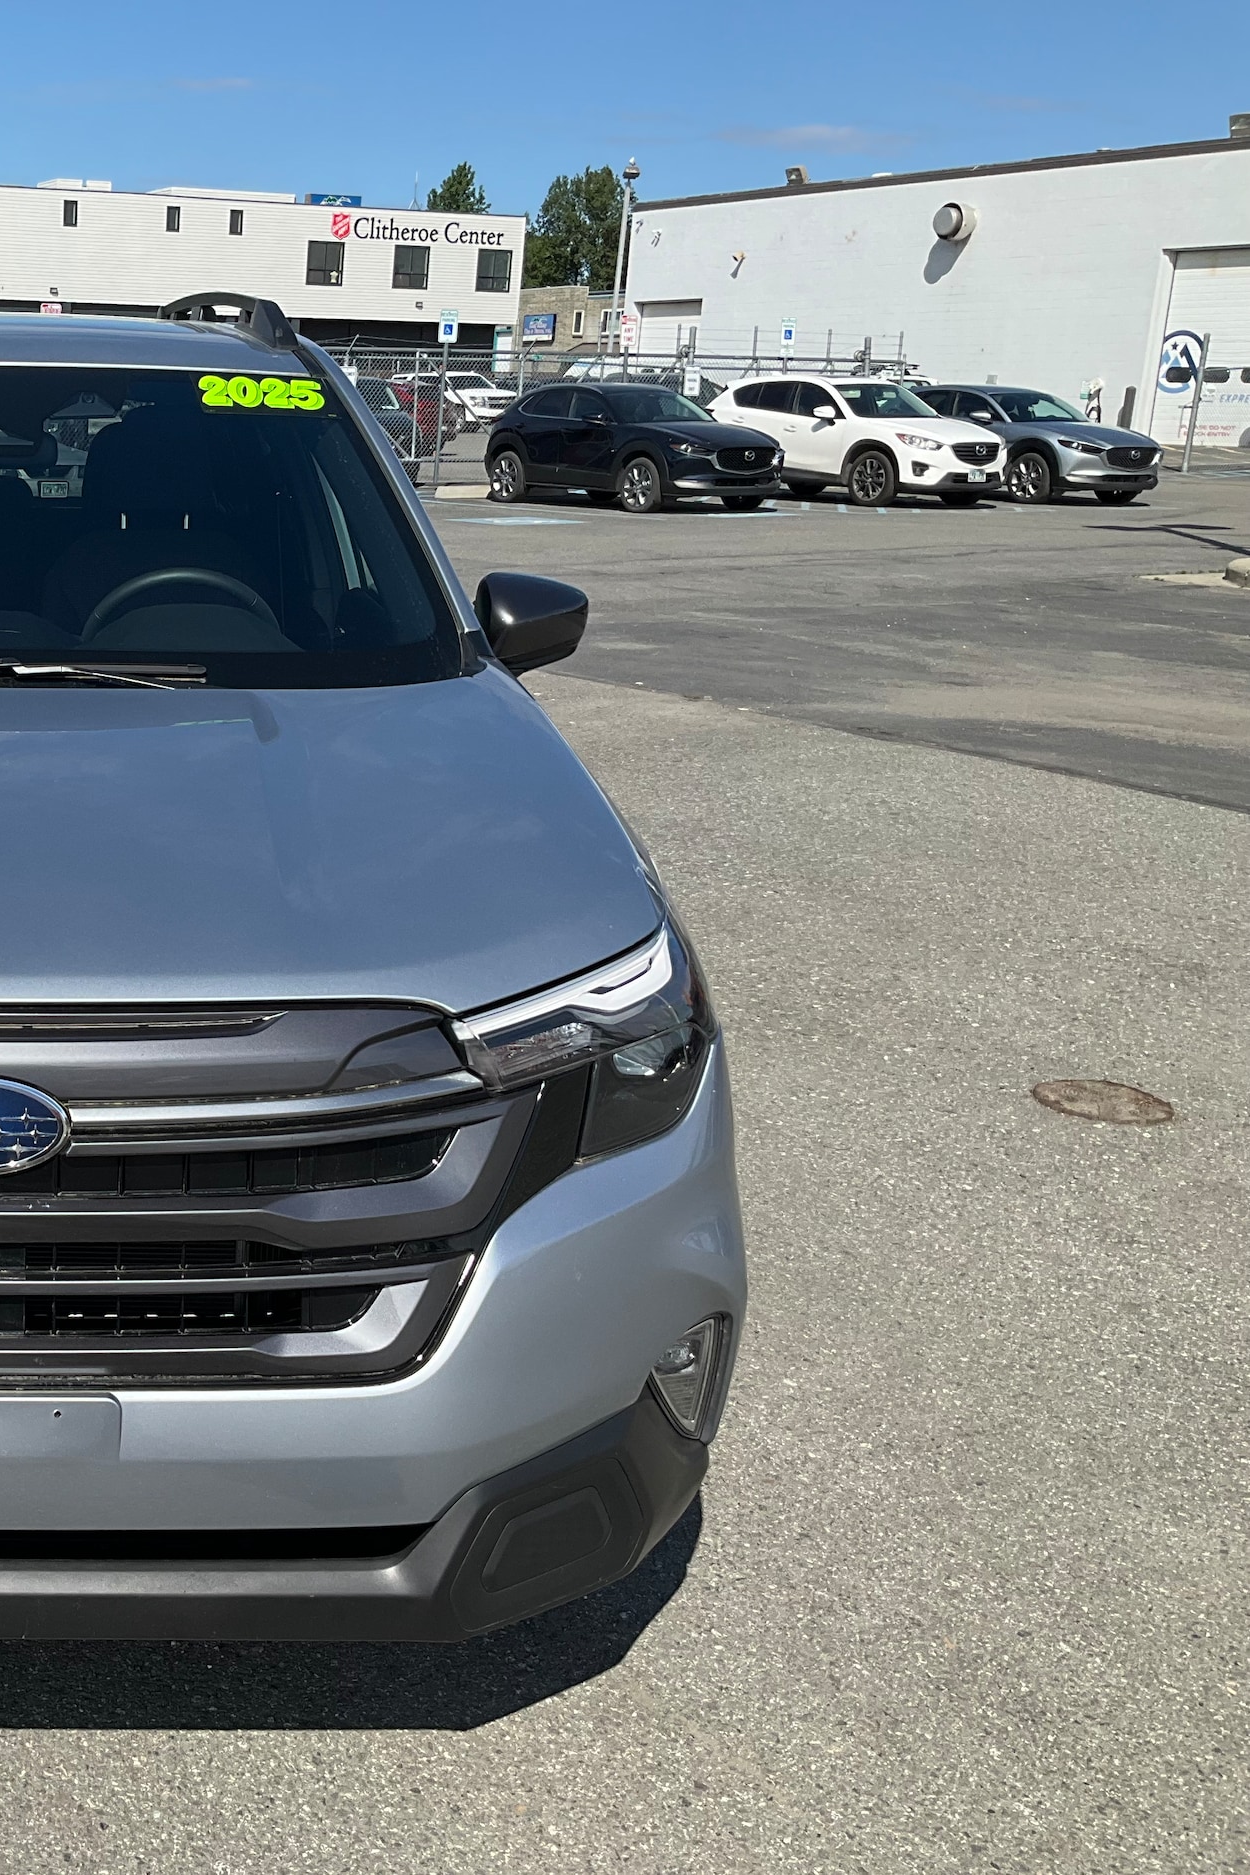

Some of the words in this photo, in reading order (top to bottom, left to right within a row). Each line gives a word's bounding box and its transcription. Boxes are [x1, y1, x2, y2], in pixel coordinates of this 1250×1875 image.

[353, 217, 438, 242] Clitheroe
[444, 222, 505, 246] Center
[198, 375, 325, 410] 2025
